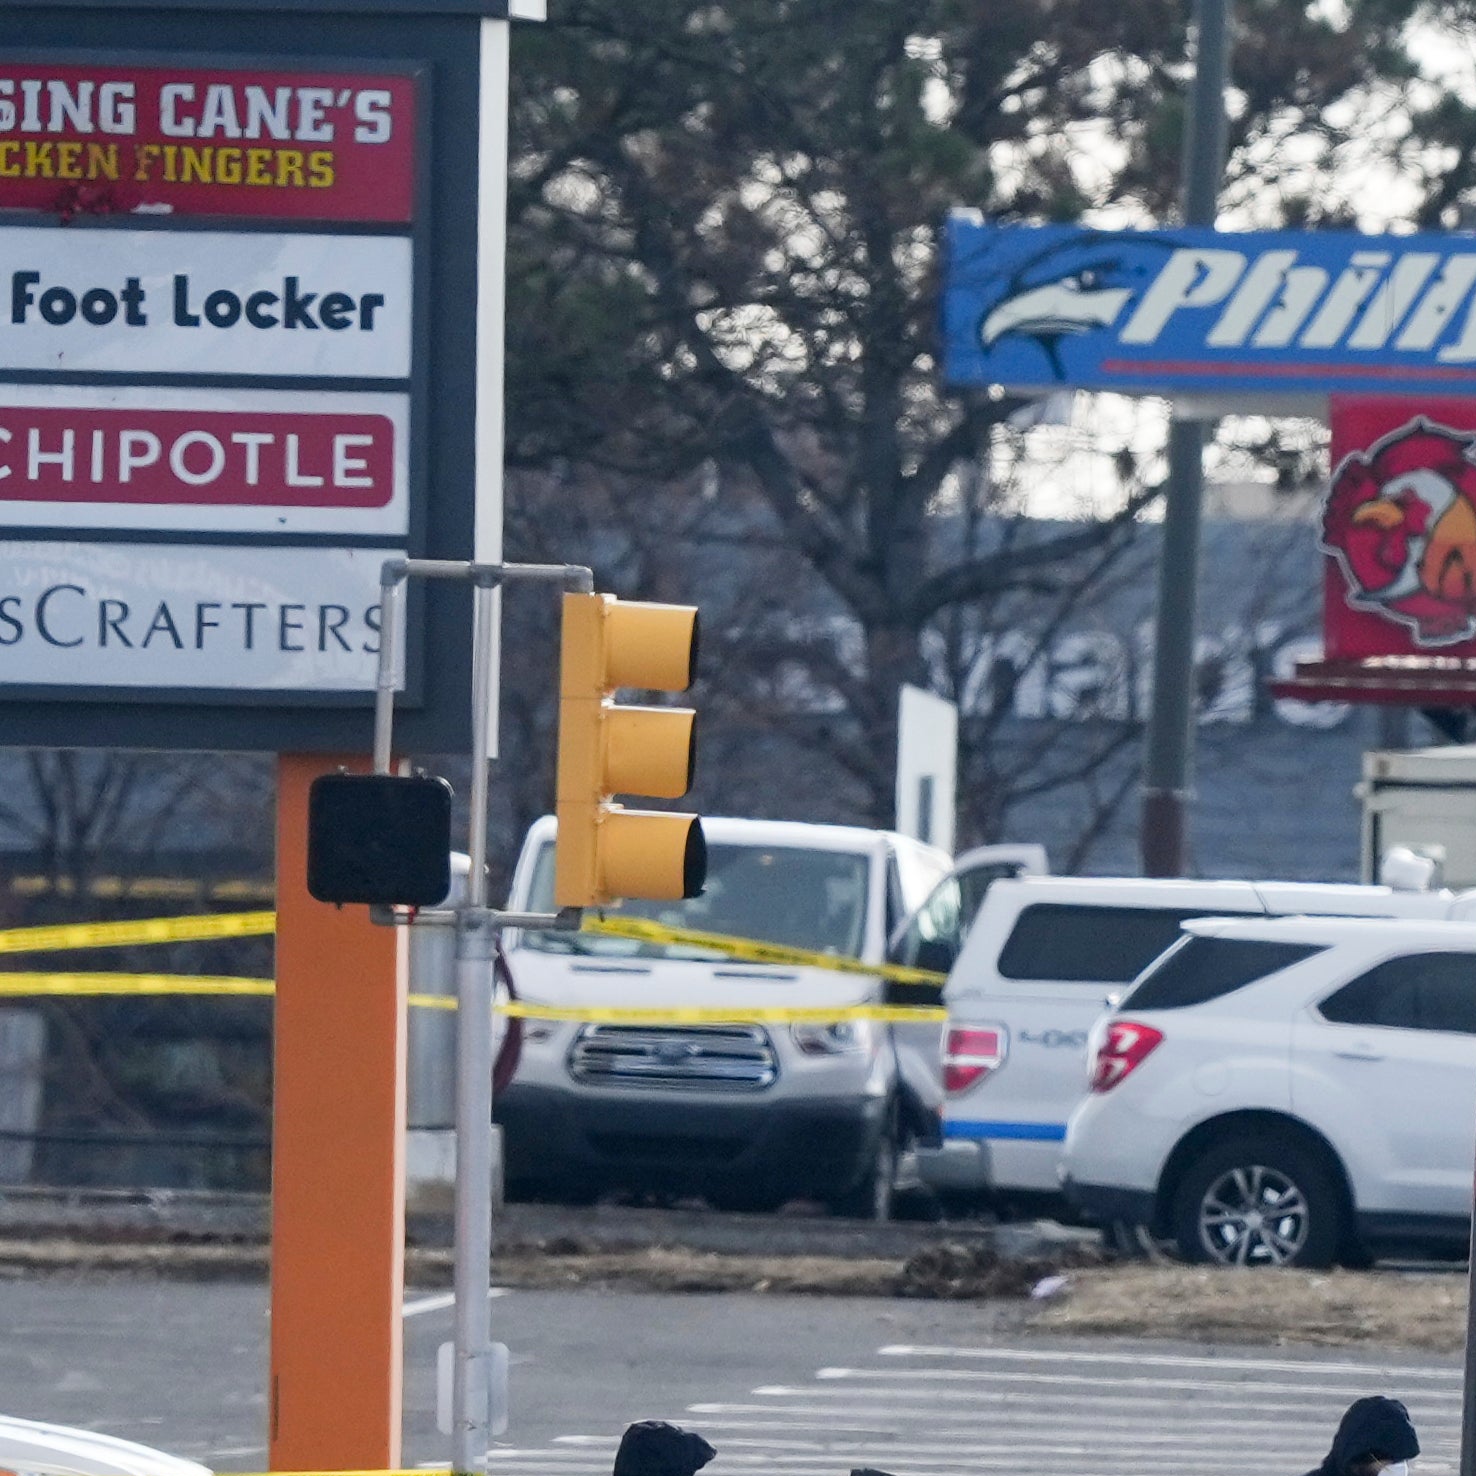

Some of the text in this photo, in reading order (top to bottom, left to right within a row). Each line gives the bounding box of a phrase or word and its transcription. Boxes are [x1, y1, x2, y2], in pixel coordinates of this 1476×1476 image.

[159, 82, 392, 144] CANE'S
[135, 144, 335, 188] FINGERS
[11, 271, 384, 331] Foot Locker
[0, 426, 375, 489] HIPOTLE
